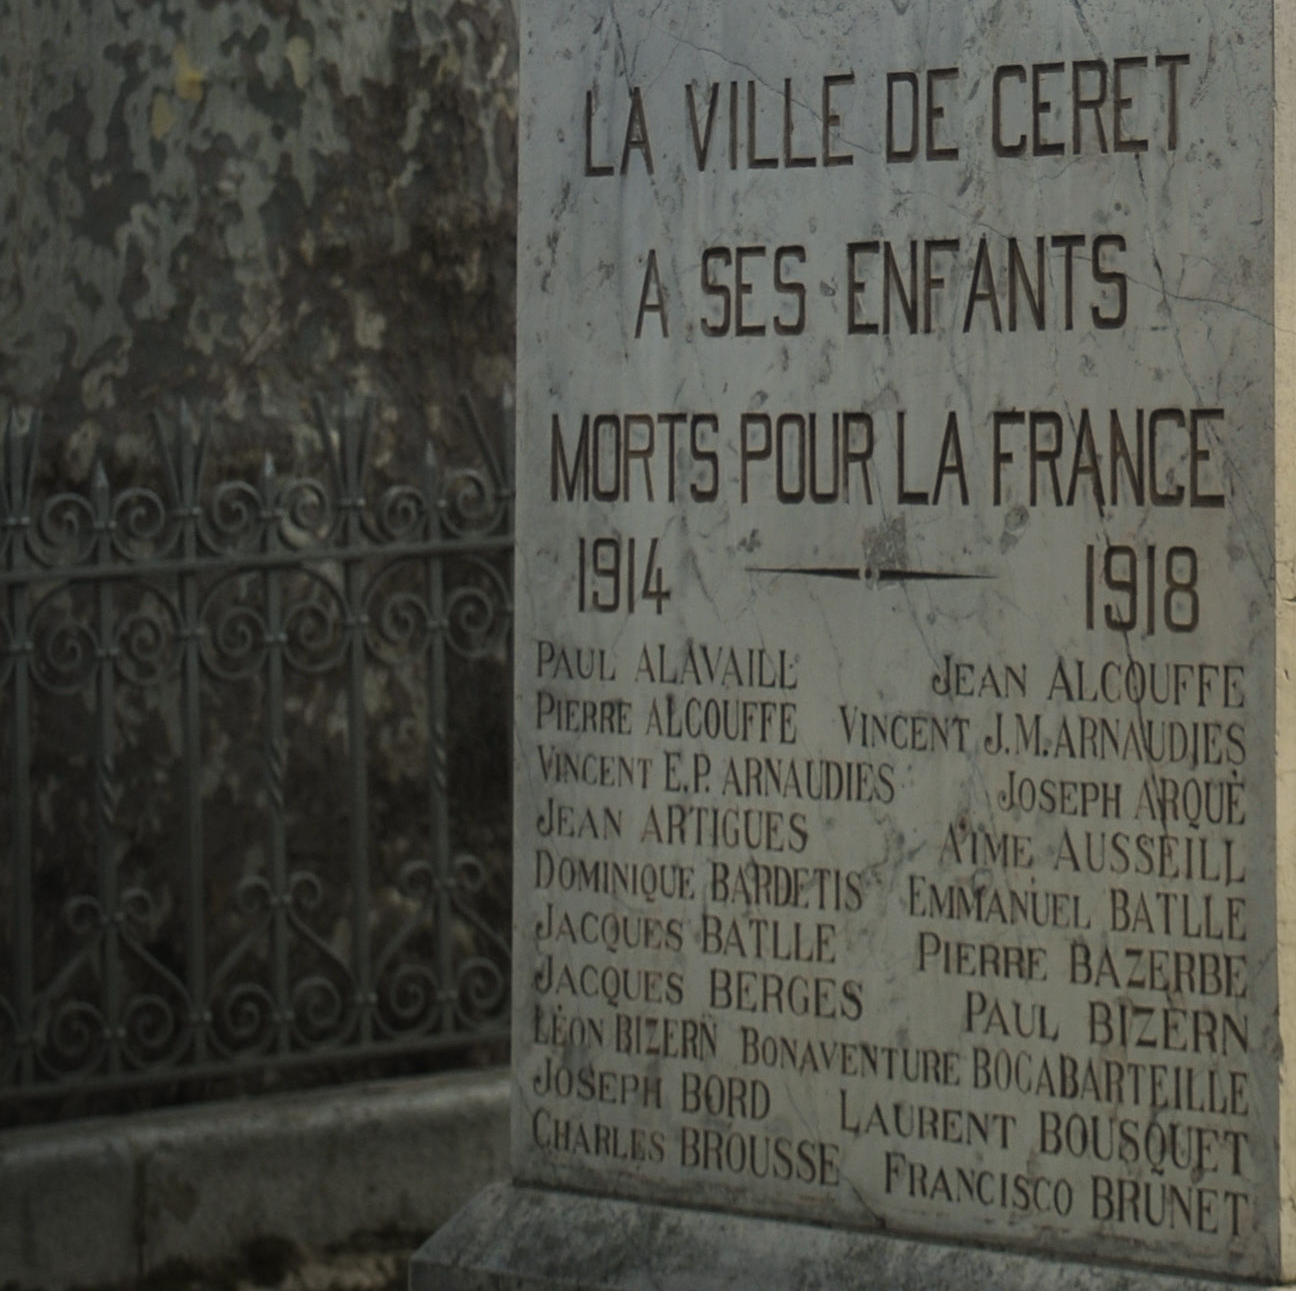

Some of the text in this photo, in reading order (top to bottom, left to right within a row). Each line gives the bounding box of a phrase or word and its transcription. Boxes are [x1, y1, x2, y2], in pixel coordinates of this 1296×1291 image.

[583, 53, 1190, 177] LA VILLE DE CERET
[634, 235, 1128, 338] A SES ENFANTS
[550, 408, 1225, 509] MORTS POUR LA FRANCE
[577, 538, 1199, 633] 1914 1918
[536, 640, 798, 690] PAUL ALAVAILL
[931, 653, 1245, 709] JEAN ALCOUFFE
[536, 691, 797, 745] PIERRE ALCOUFFE
[838, 704, 970, 753] VINCENT
[1053, 716, 1247, 771] ARNAUDIES
[538, 744, 652, 790] VINCENT
[722, 757, 894, 804] ARNAUDIES
[998, 770, 1122, 819] JOSEPH
[536, 797, 809, 853] JEAN ARTIGUES
[1054, 825, 1247, 886] AUSSEILL
[535, 849, 864, 912] DOMINIQUE BARDETIS
[907, 873, 1247, 941] EMMANUEL BATLLE
[535, 901, 836, 964] JACQUES BATLLE
[917, 931, 1248, 999] PIERRE BAZERBE
[535, 954, 863, 1021] JACQUES BERGES
[616, 1013, 718, 1061] BIZERN
[965, 990, 1249, 1057] PAUL BIZERN
[533, 1057, 770, 1121] JOSEPH BORD
[740, 1025, 1250, 1117] BONAVENTURE BOCABARTEILLE
[532, 1107, 840, 1187] CHARLES BROUSSE
[839, 1088, 1249, 1176] LAURENT BOUSQUET
[884, 1151, 1249, 1237] FRANCISCO BRUNET
